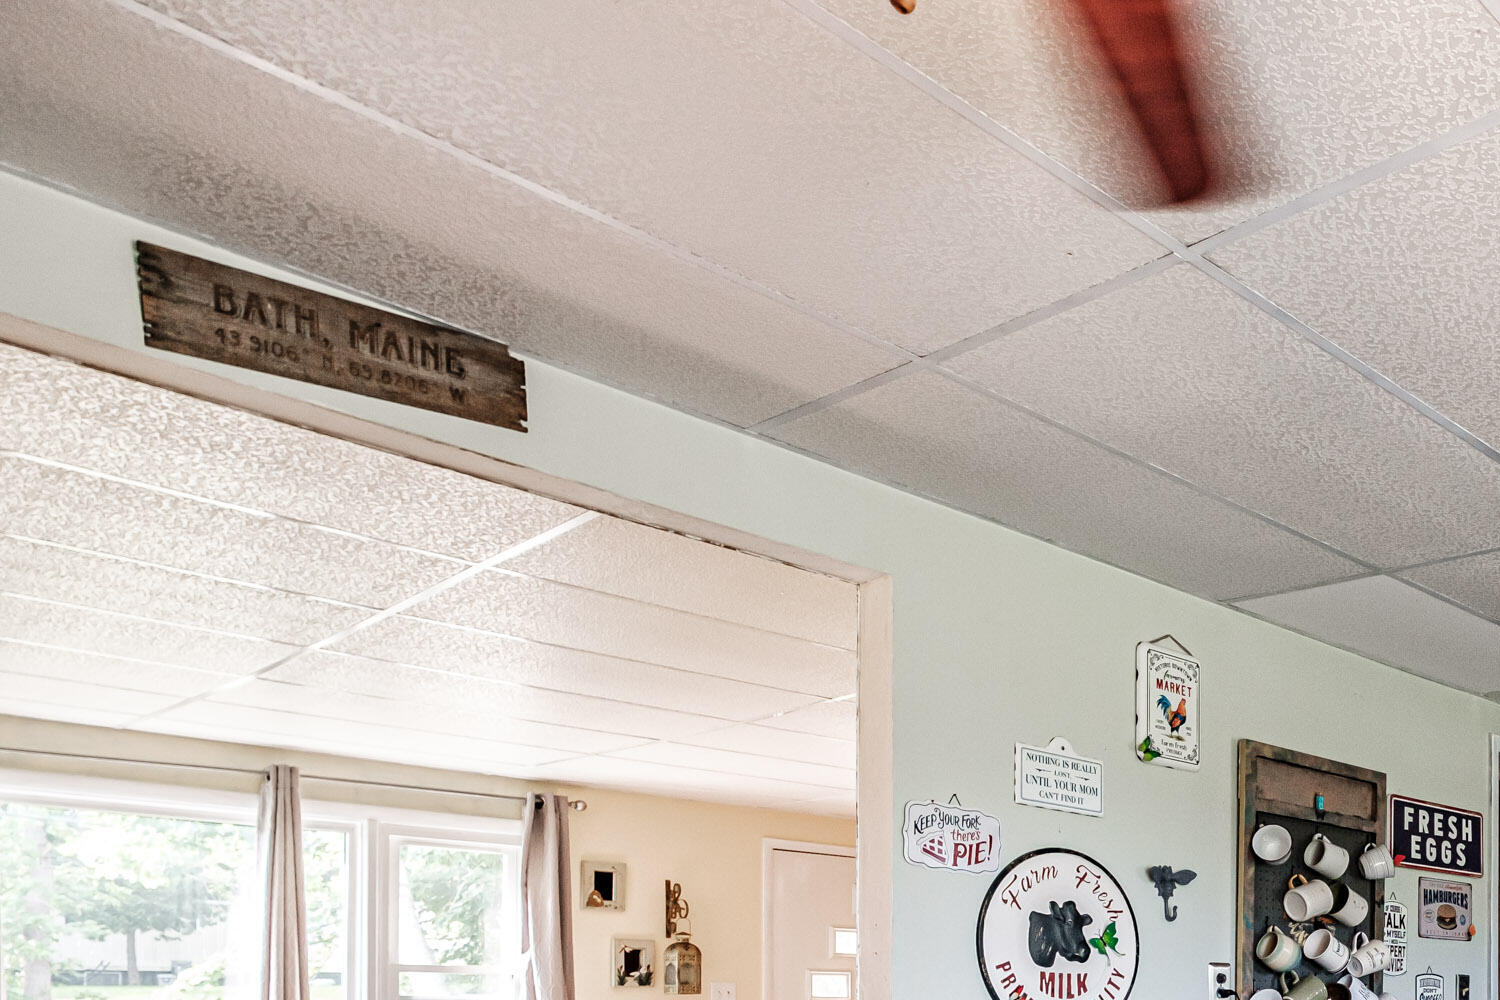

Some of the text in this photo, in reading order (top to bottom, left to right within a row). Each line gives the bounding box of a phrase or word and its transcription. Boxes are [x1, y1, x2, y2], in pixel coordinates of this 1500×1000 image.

[349, 319, 467, 381] MAINE
[1156, 678, 1192, 697] MARKET
[1026, 752, 1097, 775] NOTHING IS REALLY
[1054, 770, 1070, 779] LOST
[1025, 774, 1098, 797] UNTIL YOUR MOM
[1039, 790, 1084, 805] CAN'T FIND IT
[913, 807, 982, 835] KEEP YOUR FORK
[1403, 806, 1473, 843] FRESH
[952, 834, 993, 867] PIE!
[1410, 834, 1467, 867] EGGS
[1001, 864, 1124, 922] Farm Fresh
[1423, 888, 1469, 910] HAMBURGERS
[1387, 930, 1406, 939] MYSELF
[1387, 945, 1406, 958] PERT
[1039, 971, 1089, 1000] MILK
